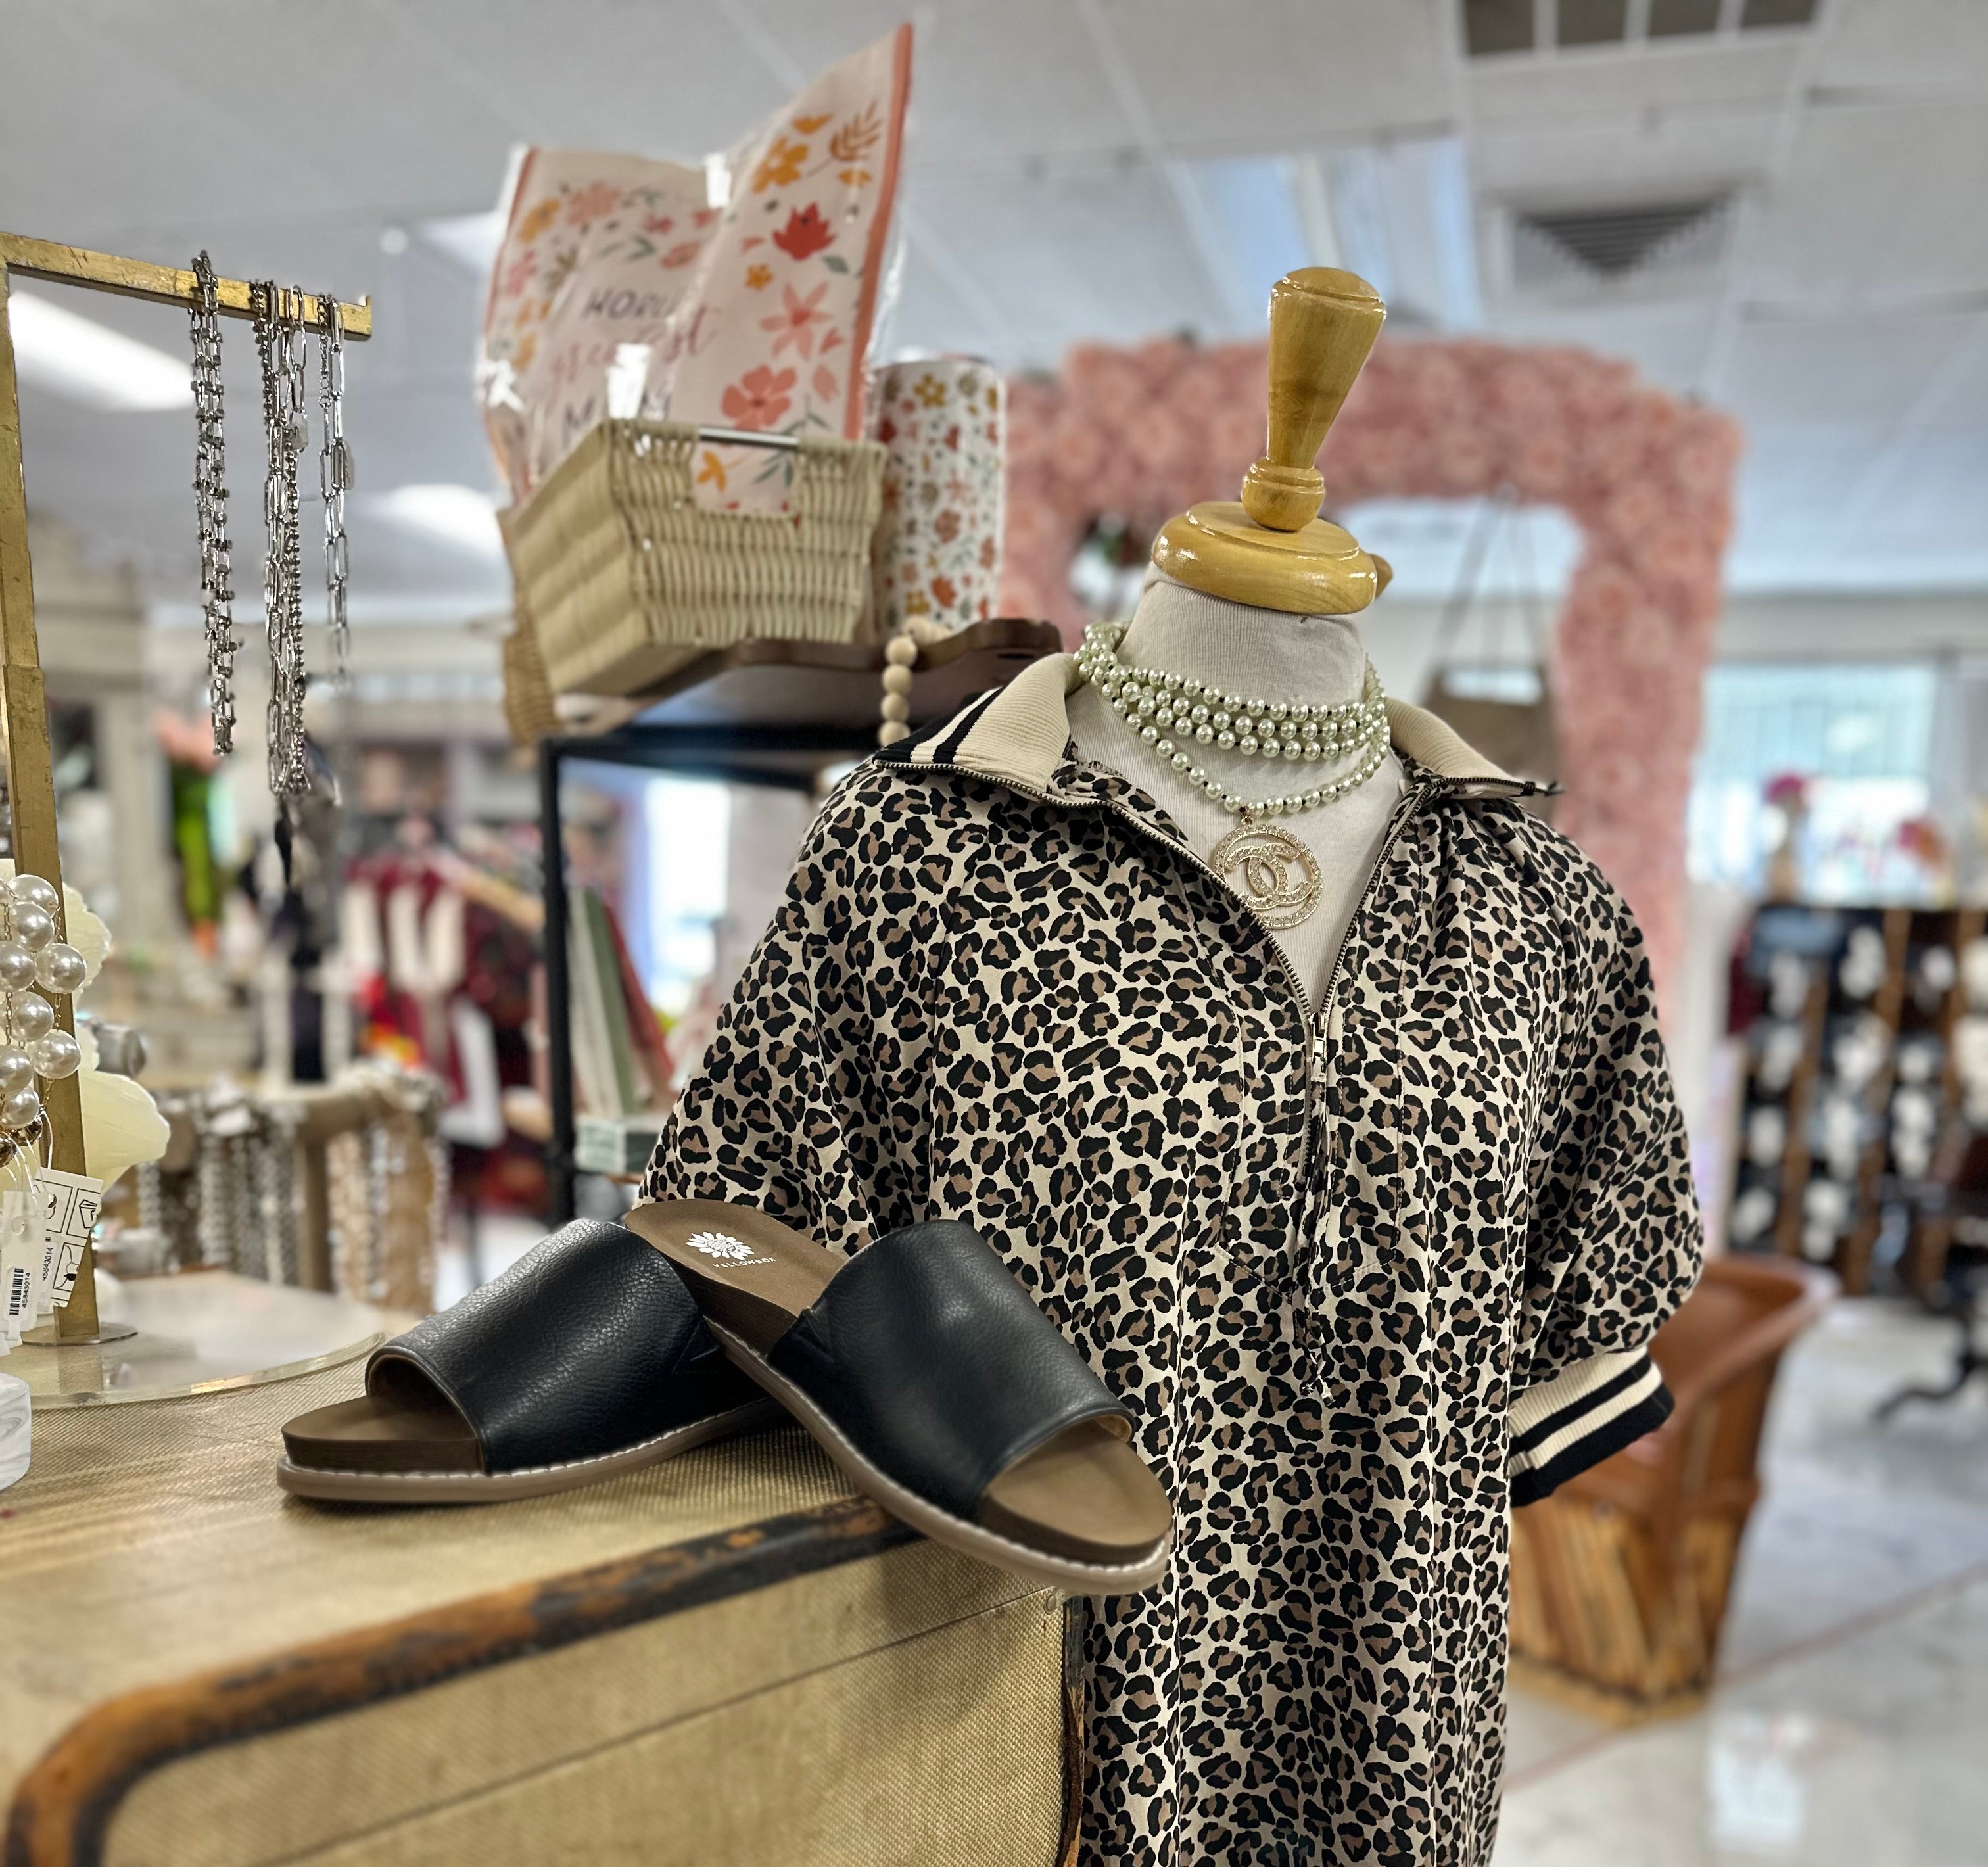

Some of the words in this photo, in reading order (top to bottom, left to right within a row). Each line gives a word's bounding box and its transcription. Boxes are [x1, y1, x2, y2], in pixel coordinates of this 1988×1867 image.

[43, 1247, 53, 1281] 45843014
[712, 1256, 777, 1268] YELLOWBOX
[22, 1272, 31, 1308] 45843014
